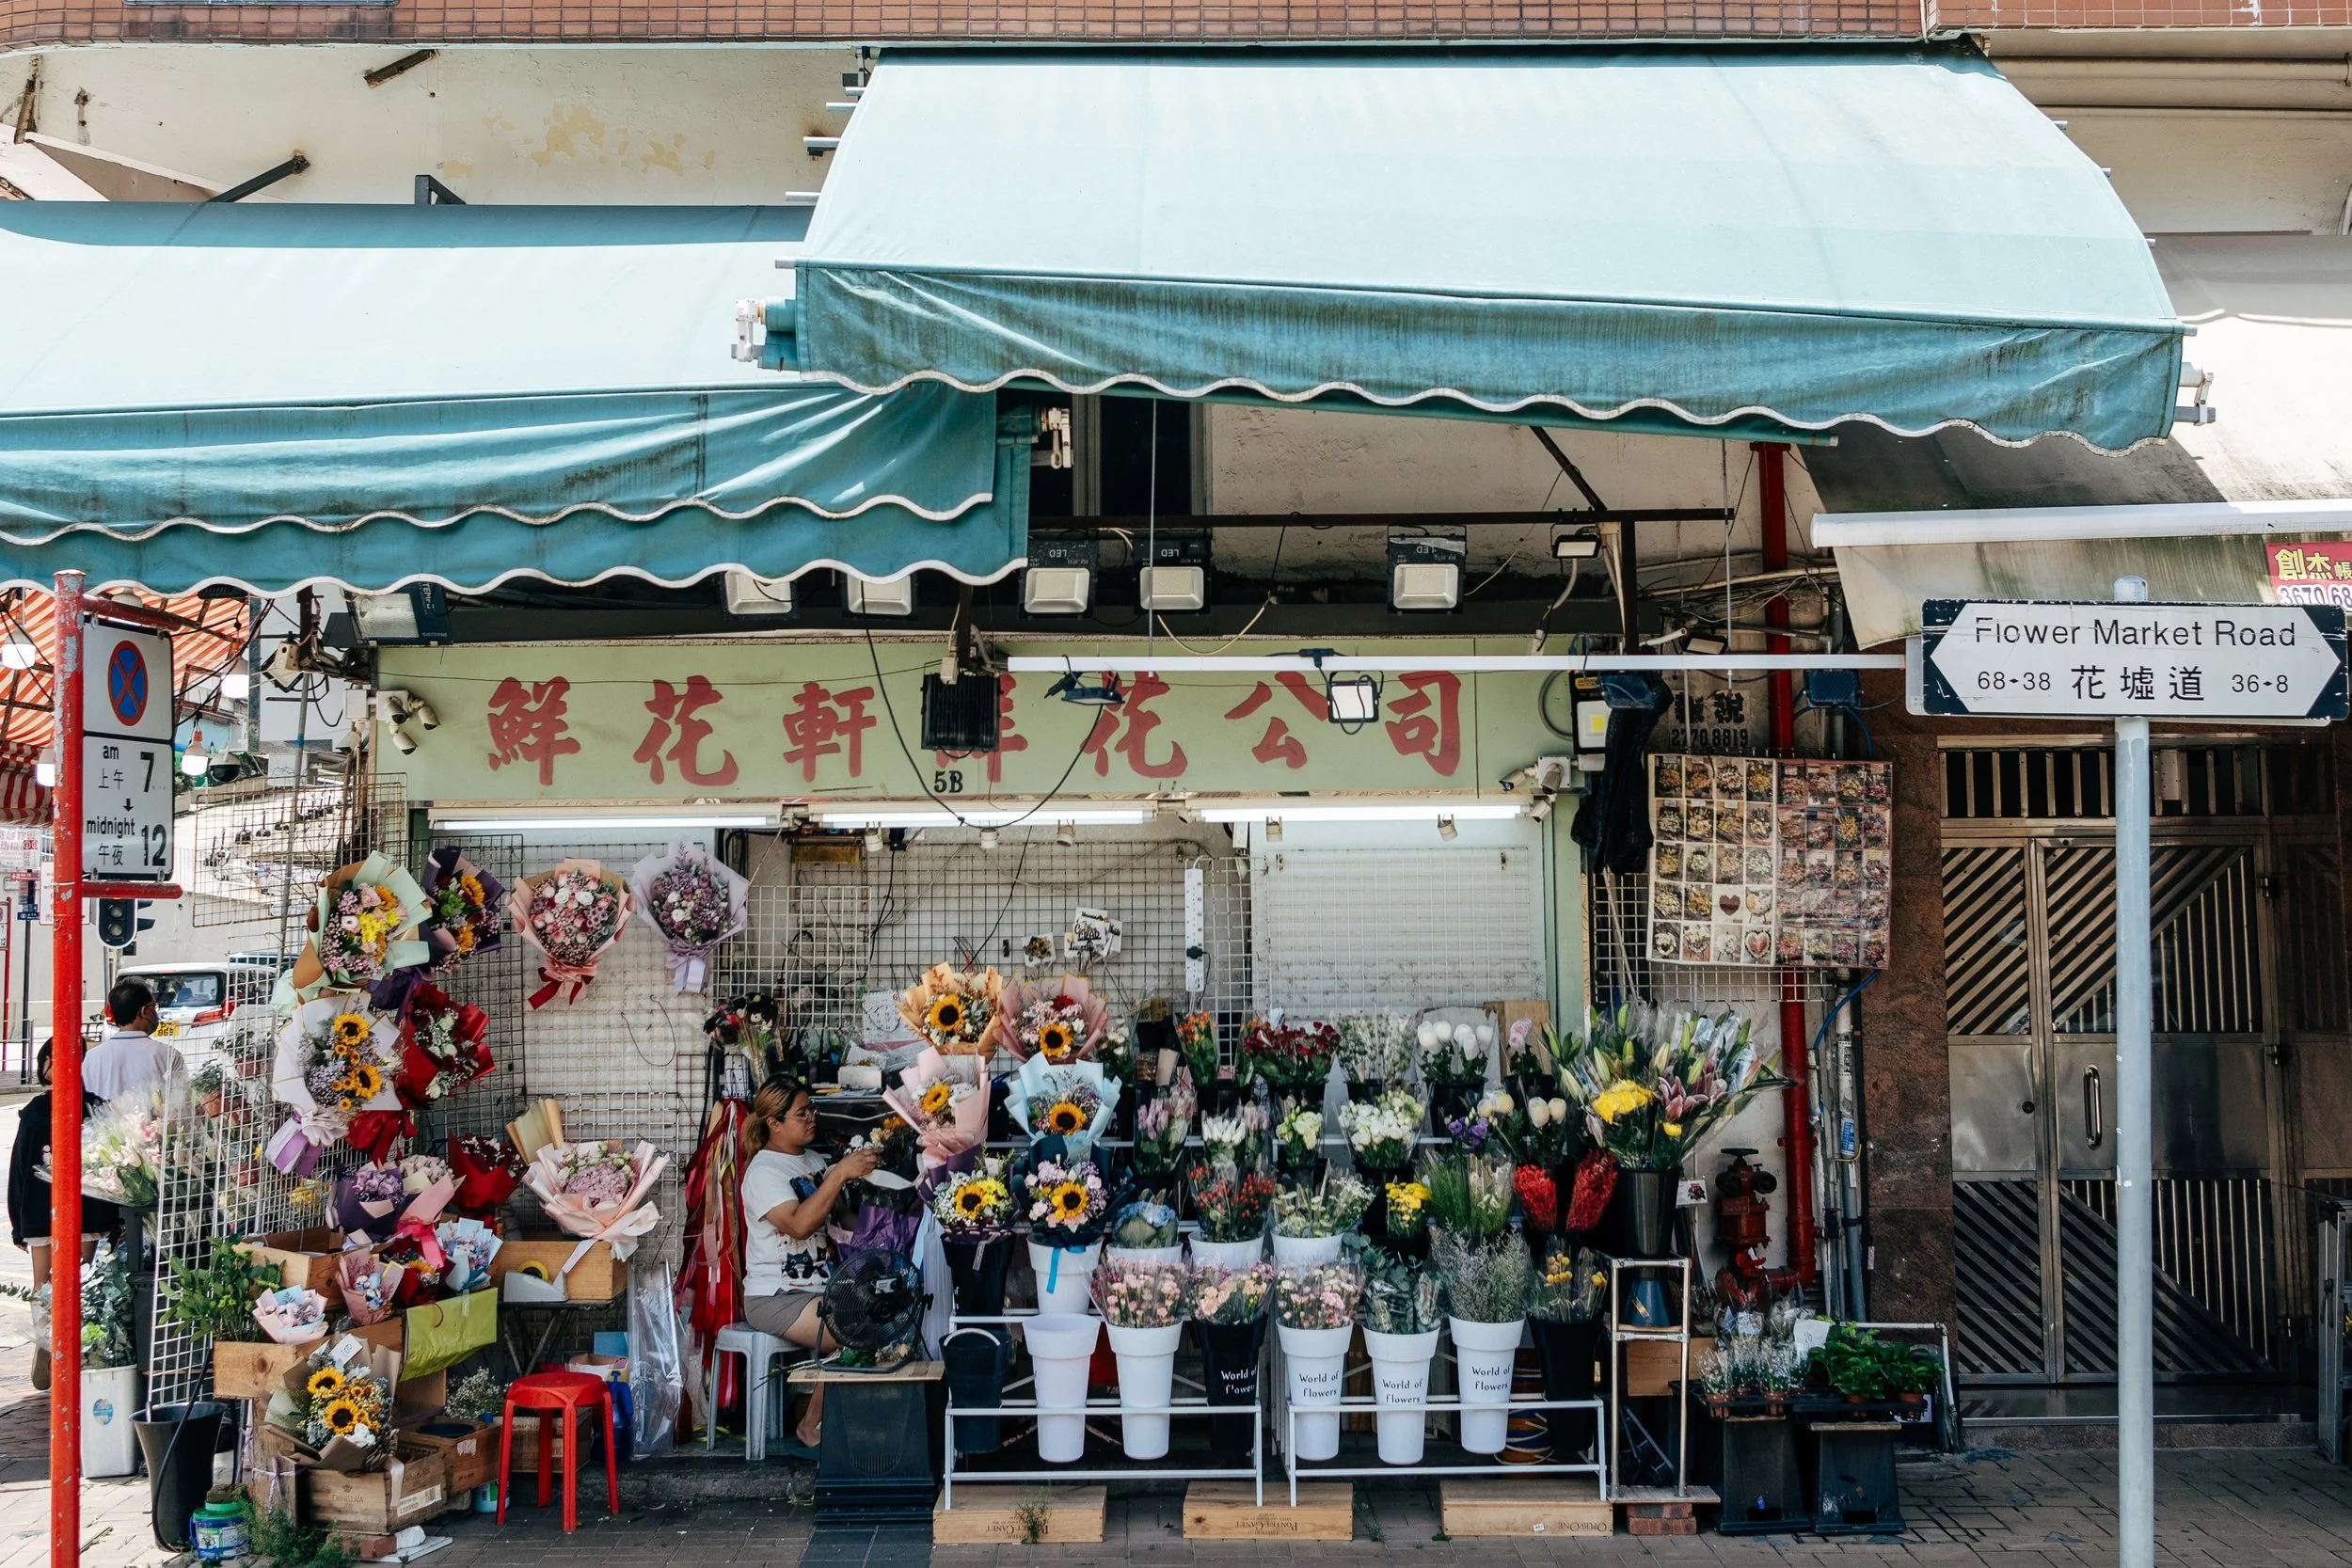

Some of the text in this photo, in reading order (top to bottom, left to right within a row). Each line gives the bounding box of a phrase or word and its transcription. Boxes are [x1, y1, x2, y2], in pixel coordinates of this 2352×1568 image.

[1049, 548, 1068, 558] LED
[1161, 548, 1180, 558] LED
[1976, 617, 2296, 647] Flower Market Road
[2071, 665, 2204, 701] 花墟道
[1712, 728, 1748, 747] 8819
[103, 745, 155, 793] am 7
[98, 768, 125, 790] 上午
[933, 770, 963, 793] 5B
[87, 816, 167, 866] midnight 12
[98, 843, 124, 866] 午夜
[1221, 1369, 1248, 1381] World
[1471, 1364, 1511, 1376] World of
[1299, 1370, 1340, 1383] World of
[1382, 1378, 1423, 1389] World of
[1474, 1381, 1508, 1391] flowers
[1303, 1387, 1337, 1398] flowers
[1386, 1393, 1421, 1403] flowers
[1581, 1522, 1607, 1531] OPUS
